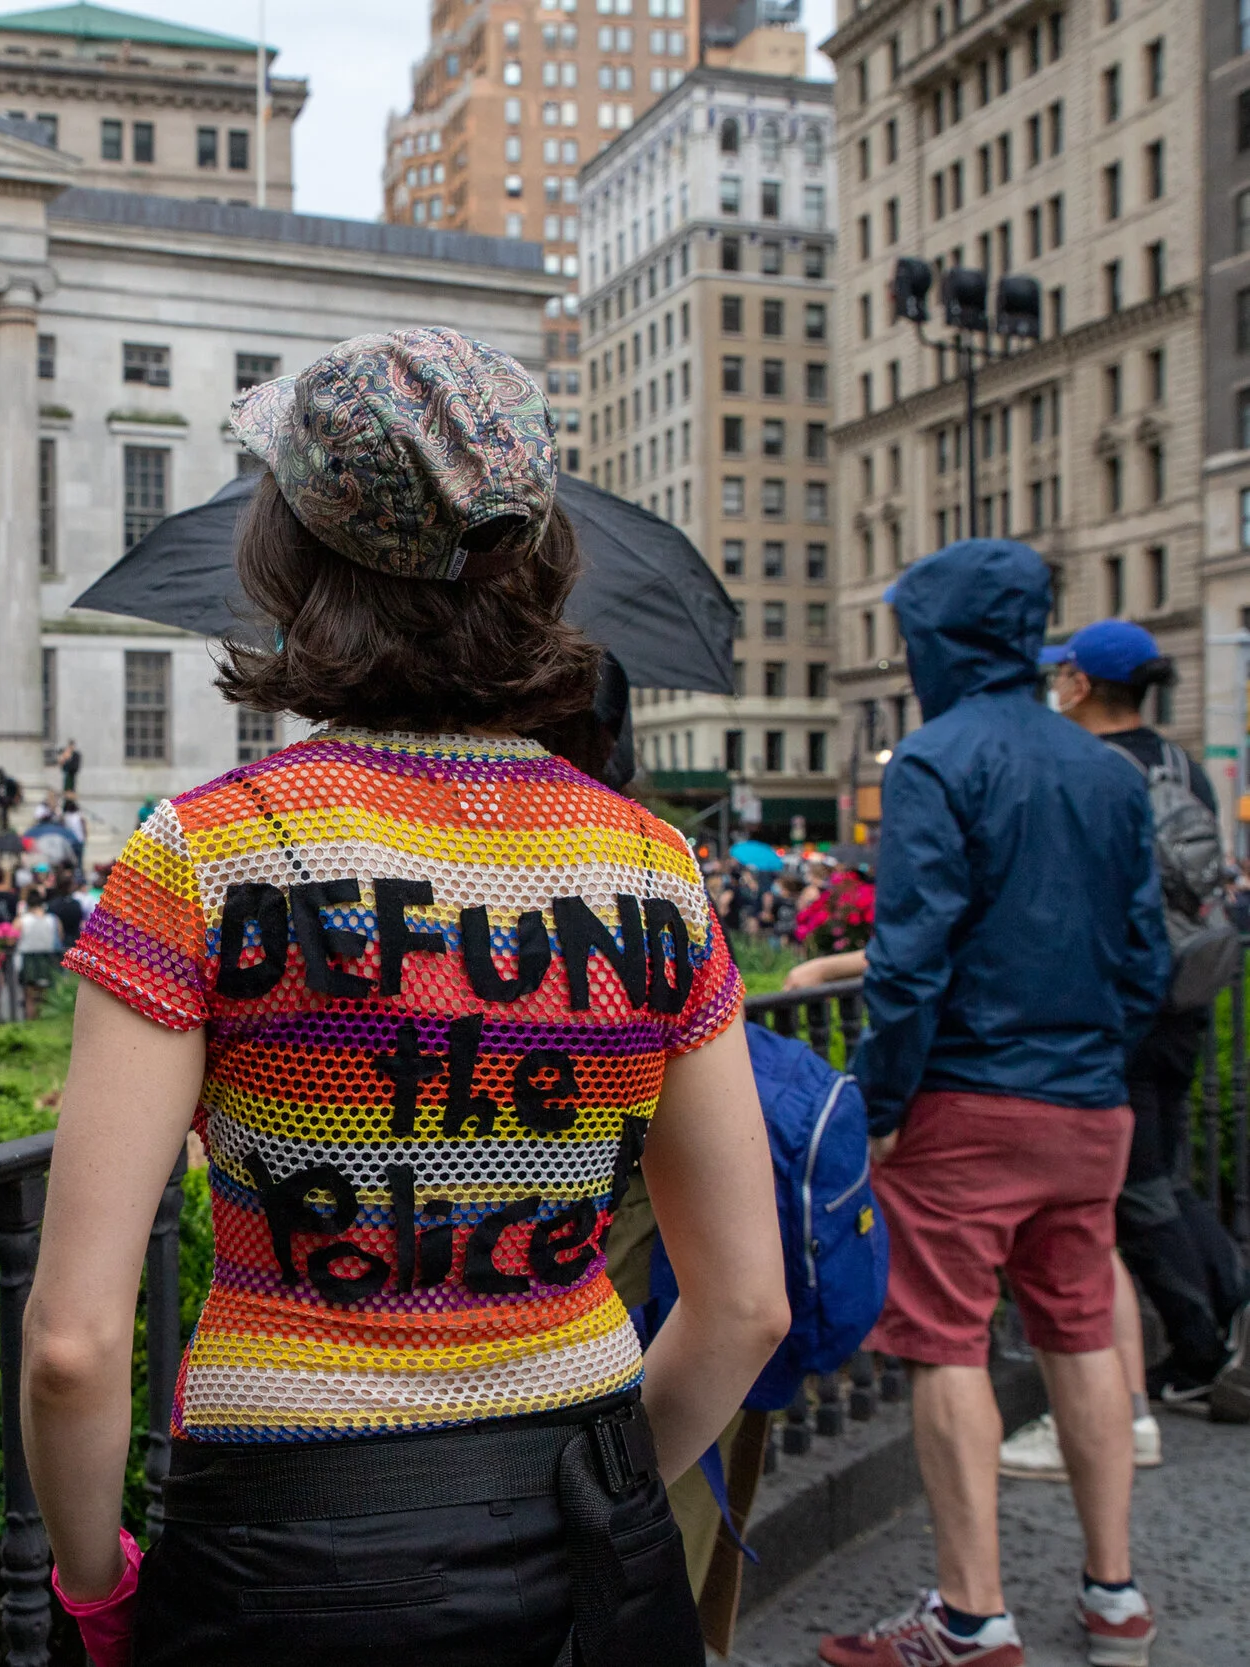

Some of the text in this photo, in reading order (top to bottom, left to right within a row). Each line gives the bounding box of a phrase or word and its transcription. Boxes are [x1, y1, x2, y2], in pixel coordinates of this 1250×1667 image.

[449, 551, 466, 579] PUBLISH
[215, 877, 693, 1013] DEFUND
[374, 1014, 580, 1138] the
[893, 1631, 942, 1667] N
